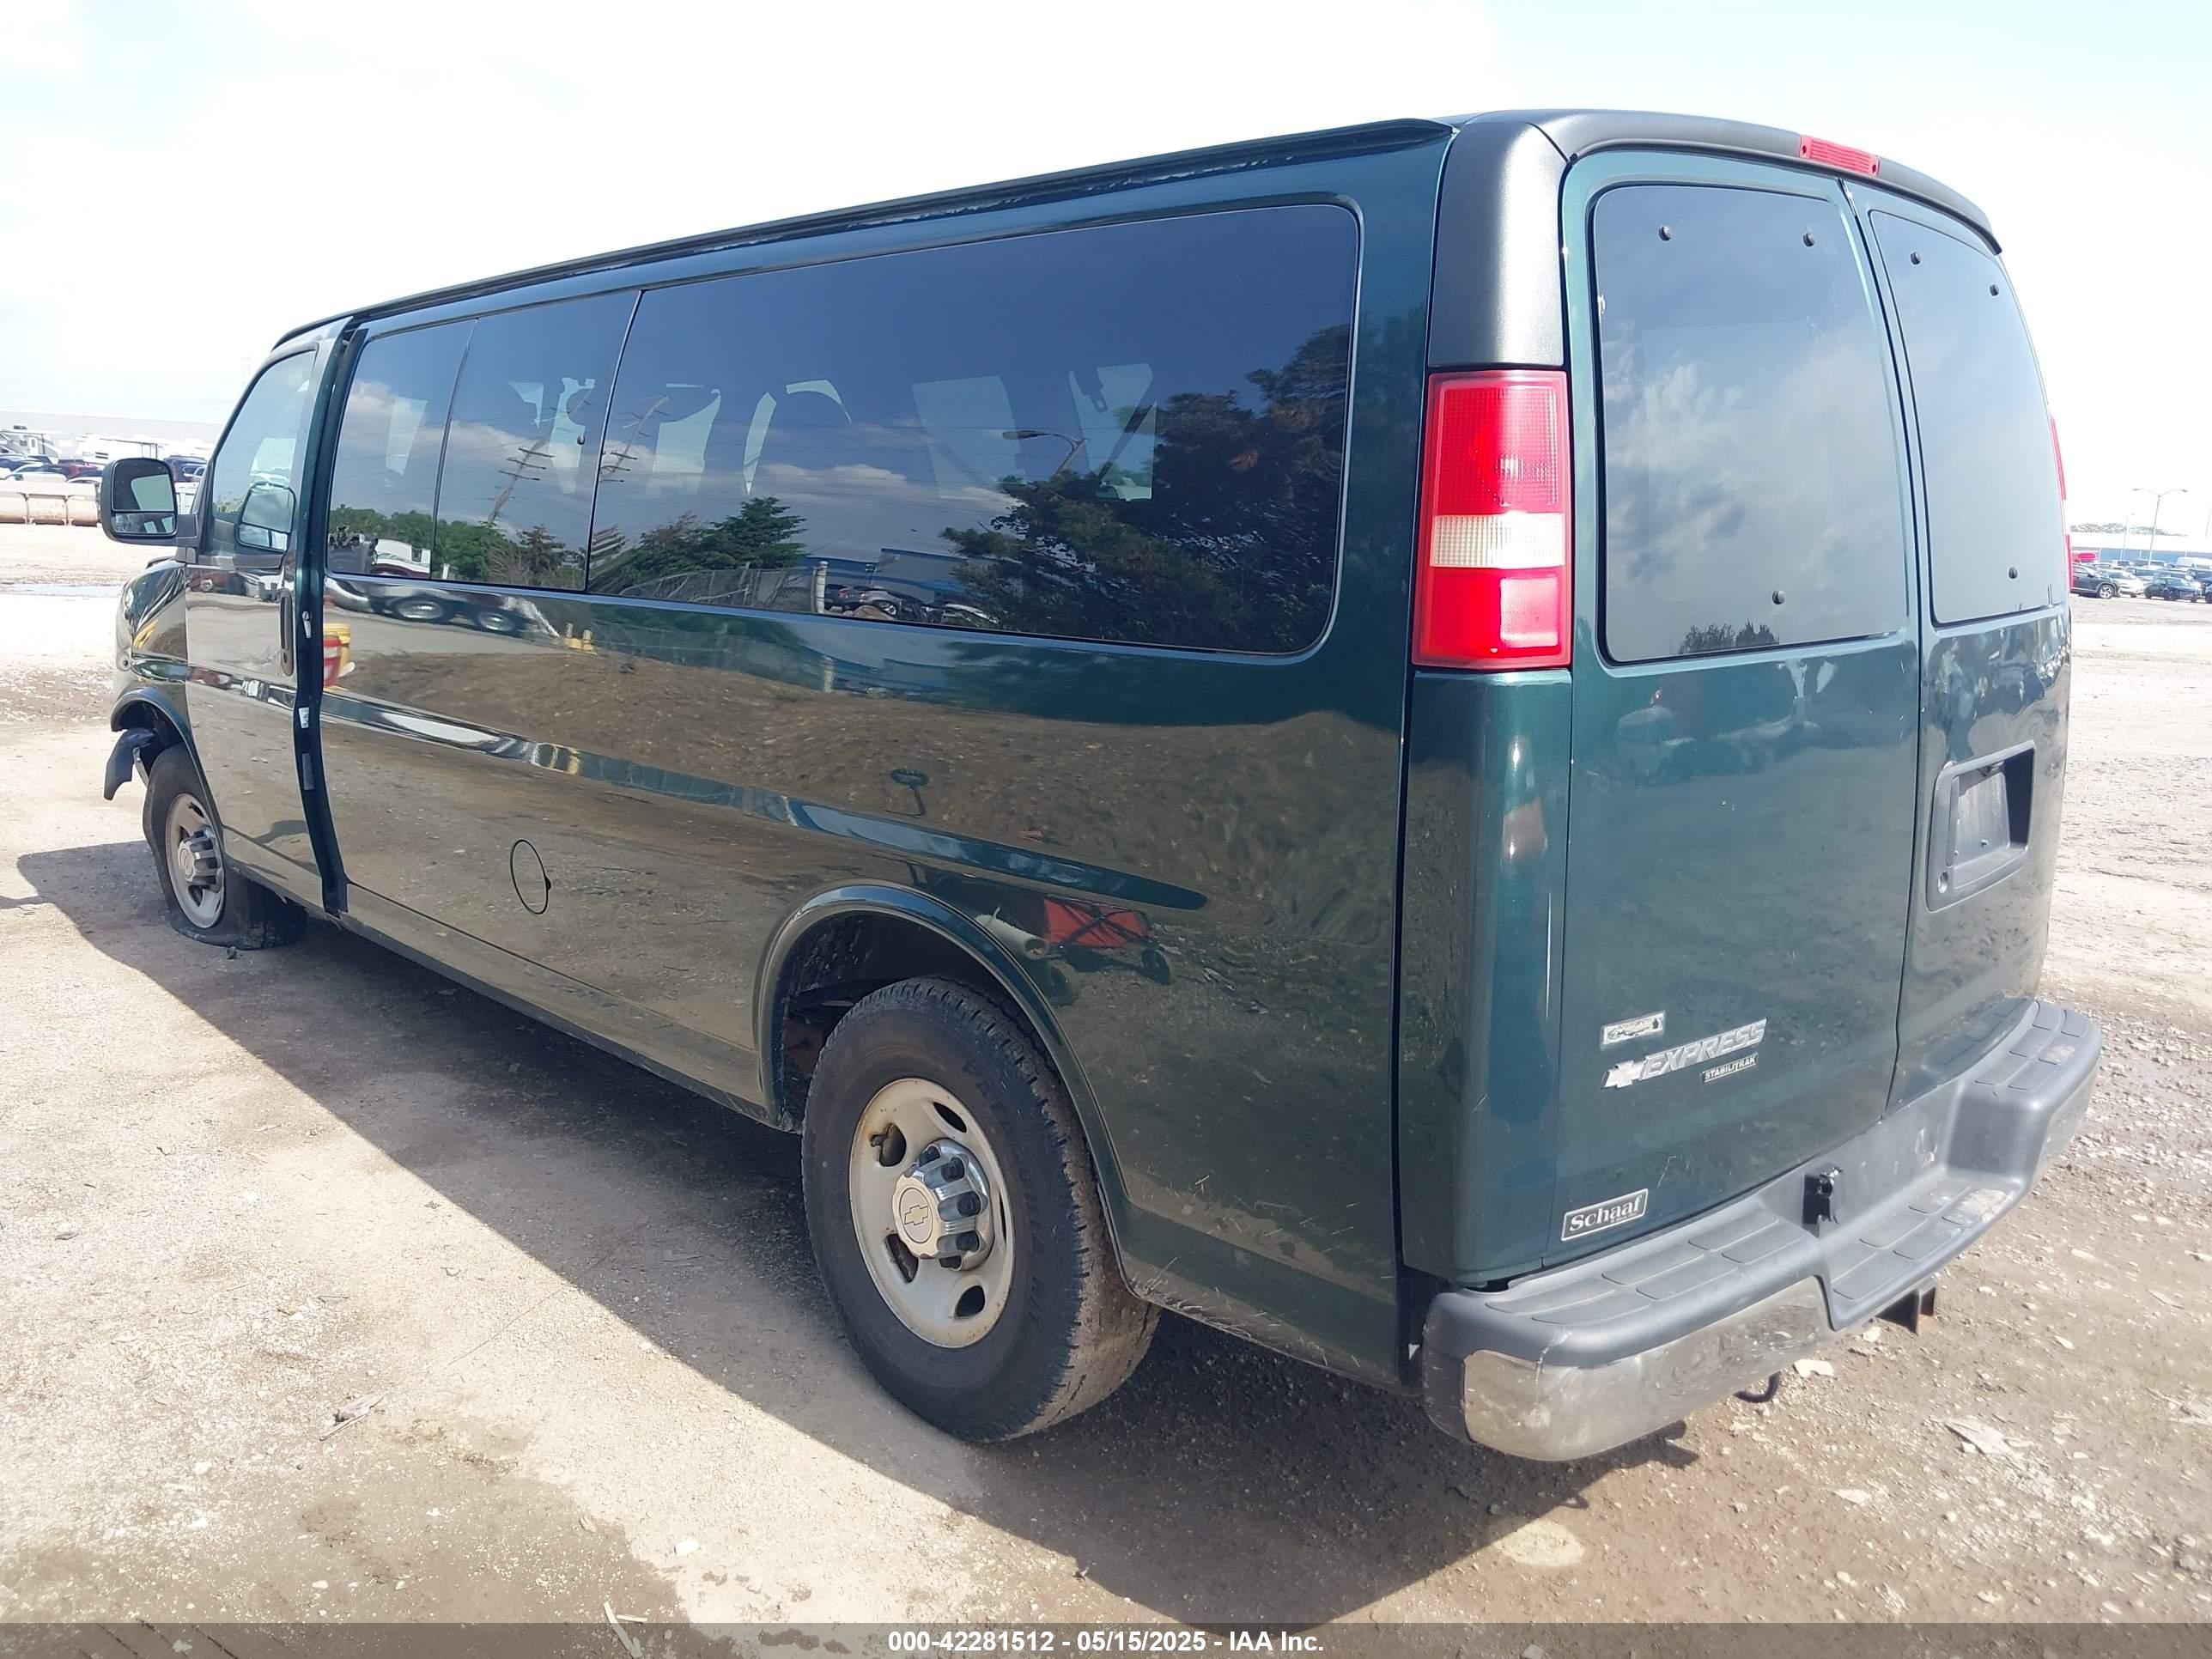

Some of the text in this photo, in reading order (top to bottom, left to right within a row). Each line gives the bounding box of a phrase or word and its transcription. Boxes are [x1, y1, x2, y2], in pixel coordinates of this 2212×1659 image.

[1641, 1018, 1767, 1080] EXPRESS
[1705, 1055, 1757, 1081] STABILITRAK
[1569, 1194, 1643, 1231] Schaaf
